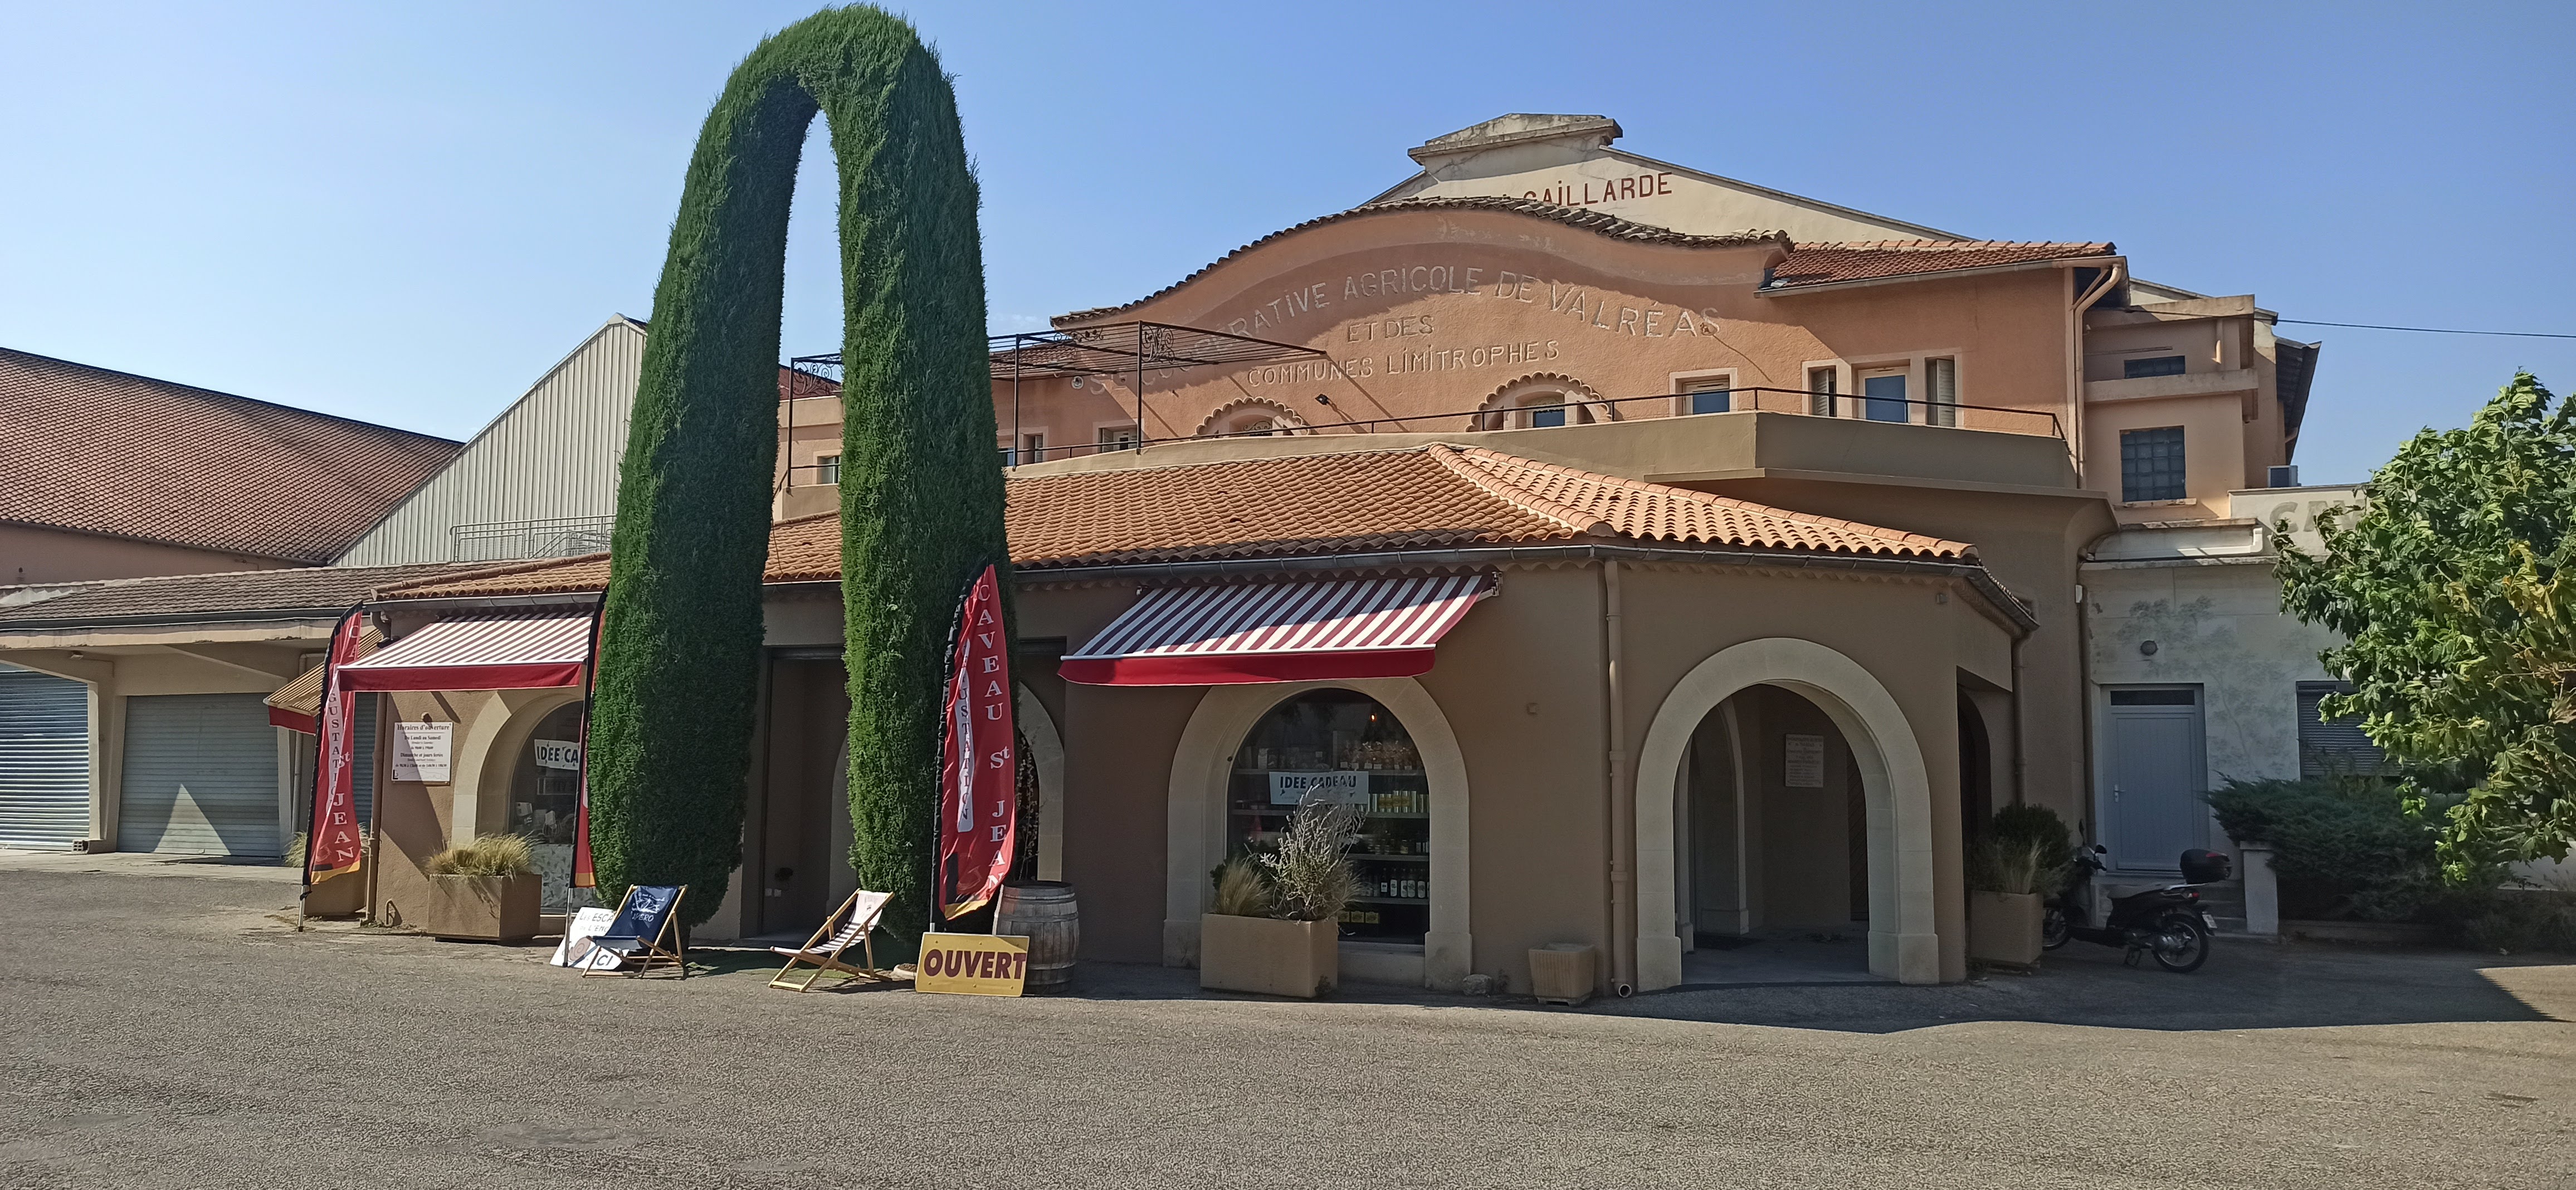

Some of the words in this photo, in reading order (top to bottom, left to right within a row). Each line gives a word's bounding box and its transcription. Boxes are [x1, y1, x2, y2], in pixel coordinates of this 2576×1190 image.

[1344, 264, 1483, 300] AGRICOLE
[1494, 270, 1538, 303] DE
[1550, 280, 1720, 338] VALRÉAS
[1347, 321, 1378, 343] ET
[1385, 314, 1435, 339] DES
[1248, 357, 1373, 387] COMMUNES
[1387, 340, 1559, 374] LIMITROPHES
[977, 585, 1003, 720] CAVEAU
[536, 746, 560, 762] IDEE
[1280, 776, 1307, 789] IDEE
[333, 793, 355, 862] JEAN
[989, 800, 1007, 889] JEAN
[924, 949, 1026, 979] OUVERT
